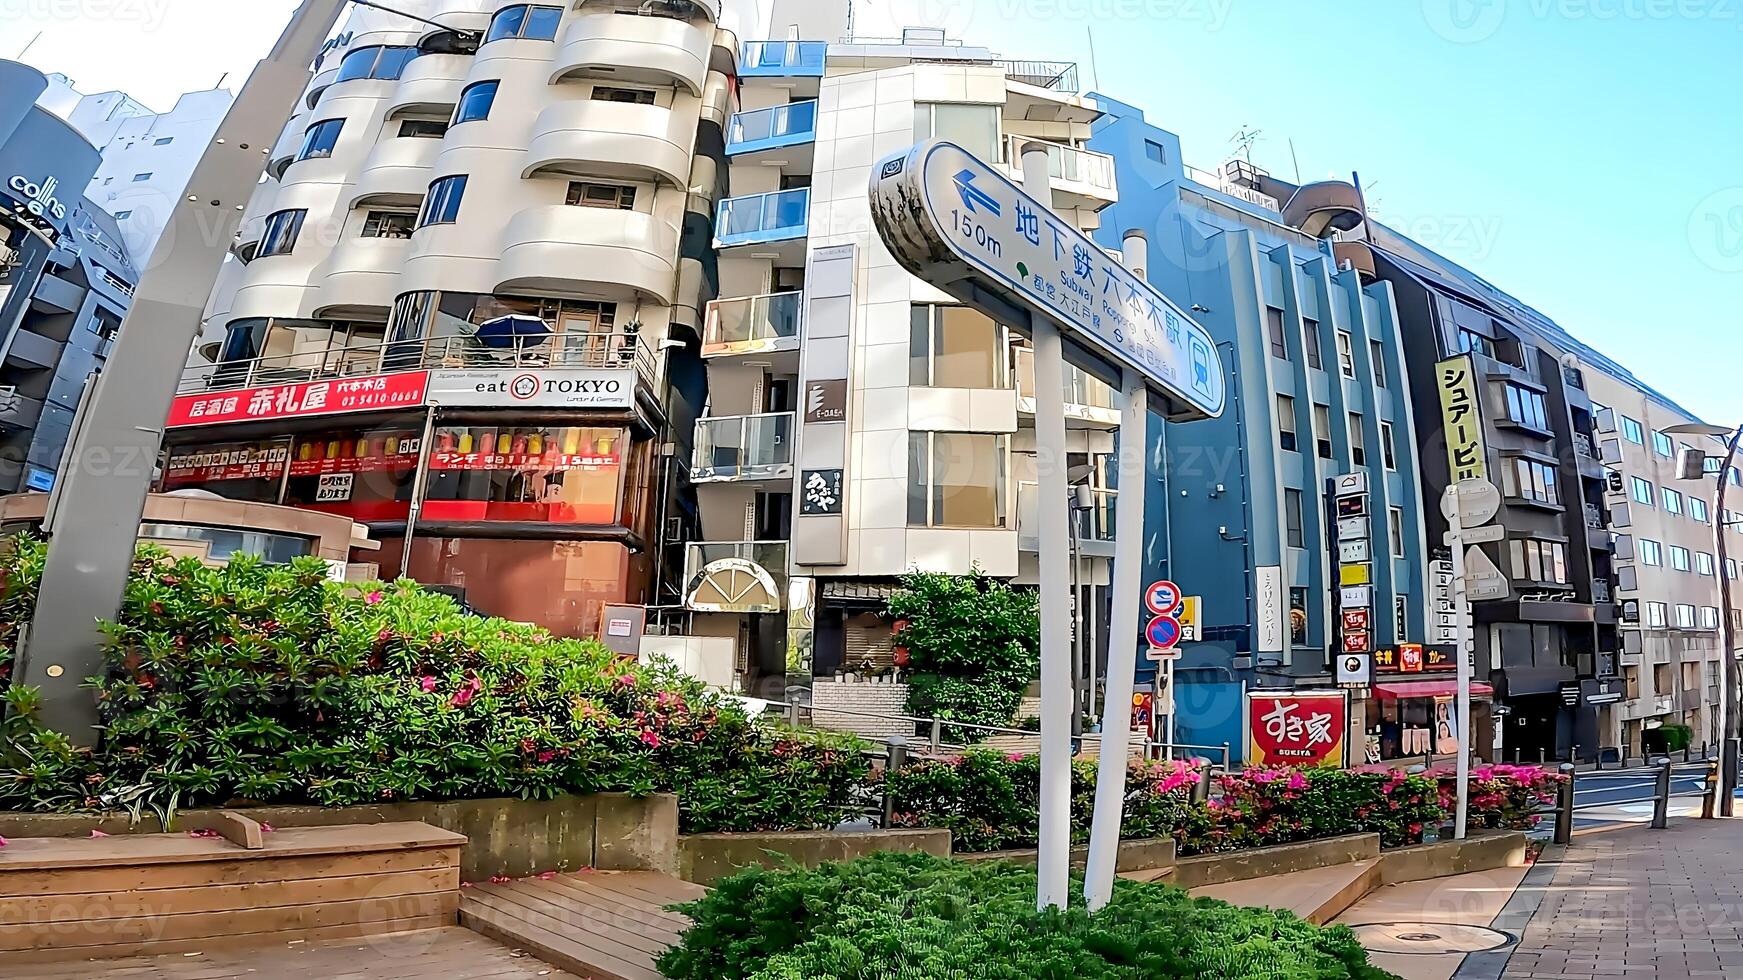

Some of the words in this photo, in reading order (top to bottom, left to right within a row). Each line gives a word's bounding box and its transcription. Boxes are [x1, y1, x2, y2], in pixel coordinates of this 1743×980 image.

[951, 209, 1001, 258] 150m
[247, 382, 330, 416] 赤札屋
[337, 377, 388, 394] 六本木店
[475, 378, 508, 393] eat
[543, 380, 620, 393] TOKYO
[436, 453, 478, 463] ランチ
[1260, 699, 1333, 749] すき家
[1278, 749, 1311, 757] SUKIYA
